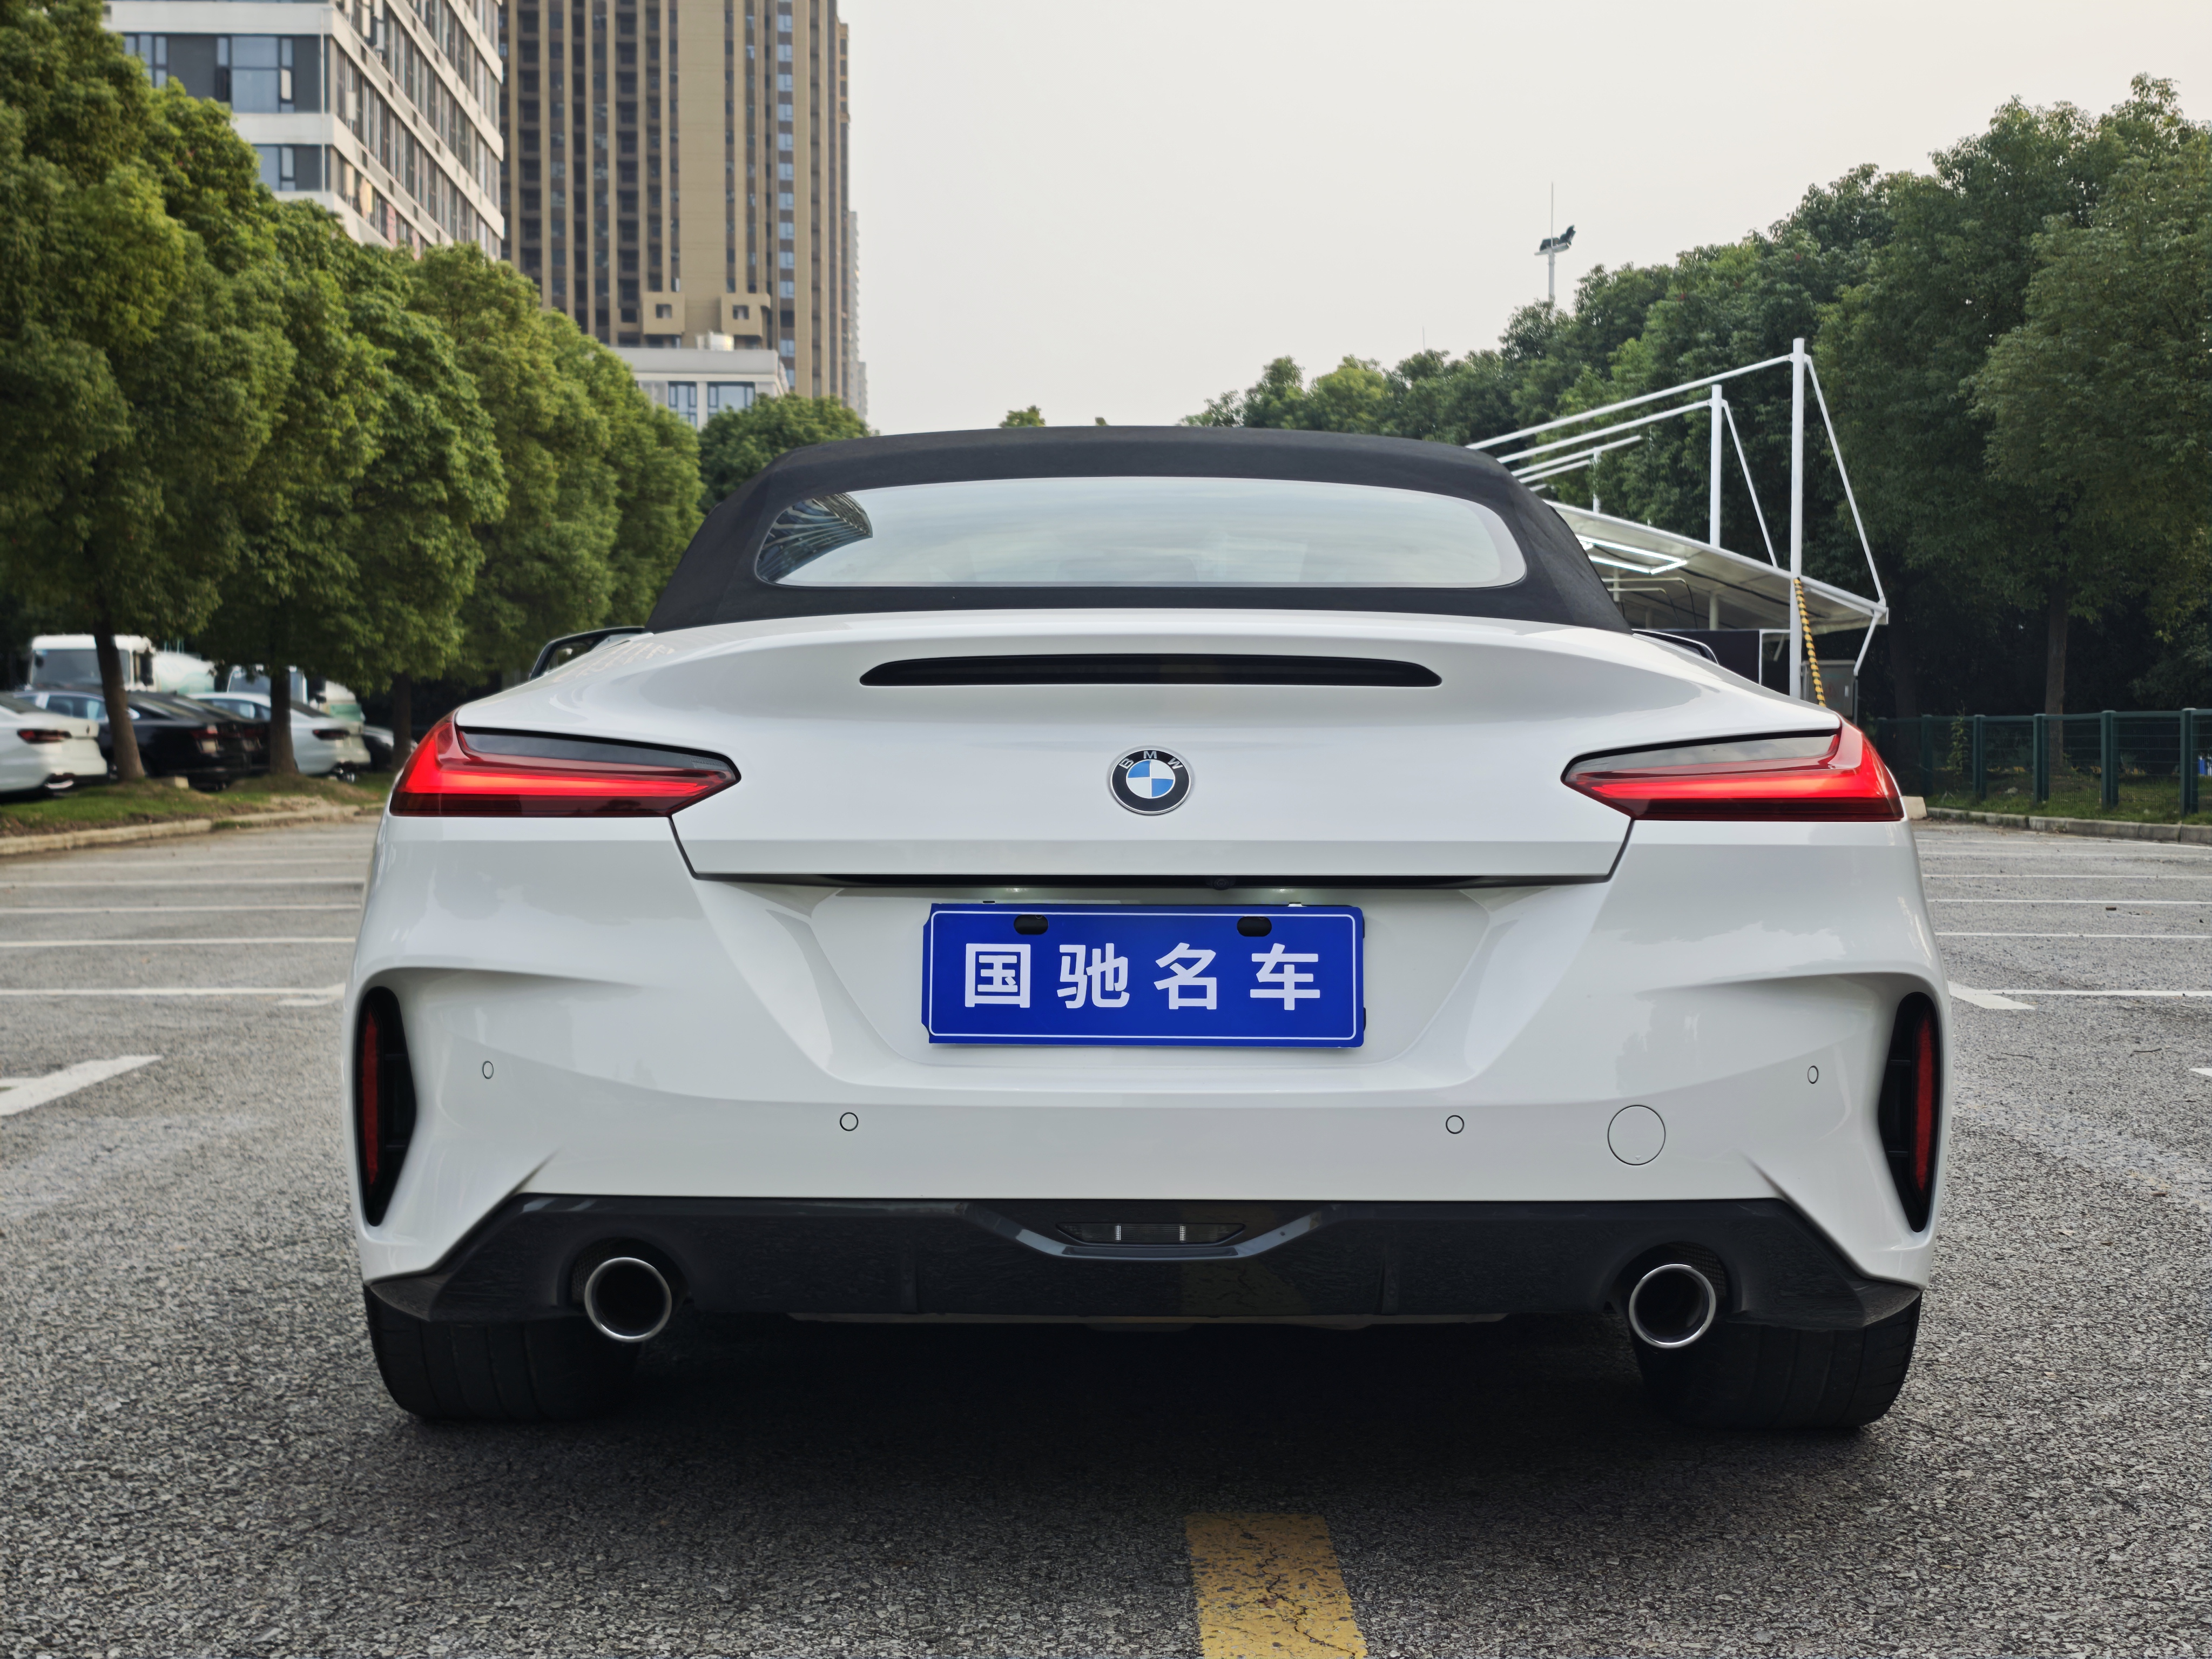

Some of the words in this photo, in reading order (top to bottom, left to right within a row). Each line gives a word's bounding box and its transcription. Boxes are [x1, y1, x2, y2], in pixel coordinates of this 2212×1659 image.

[1119, 751, 1183, 769] BMW
[965, 942, 1320, 1010] 国驰名车
